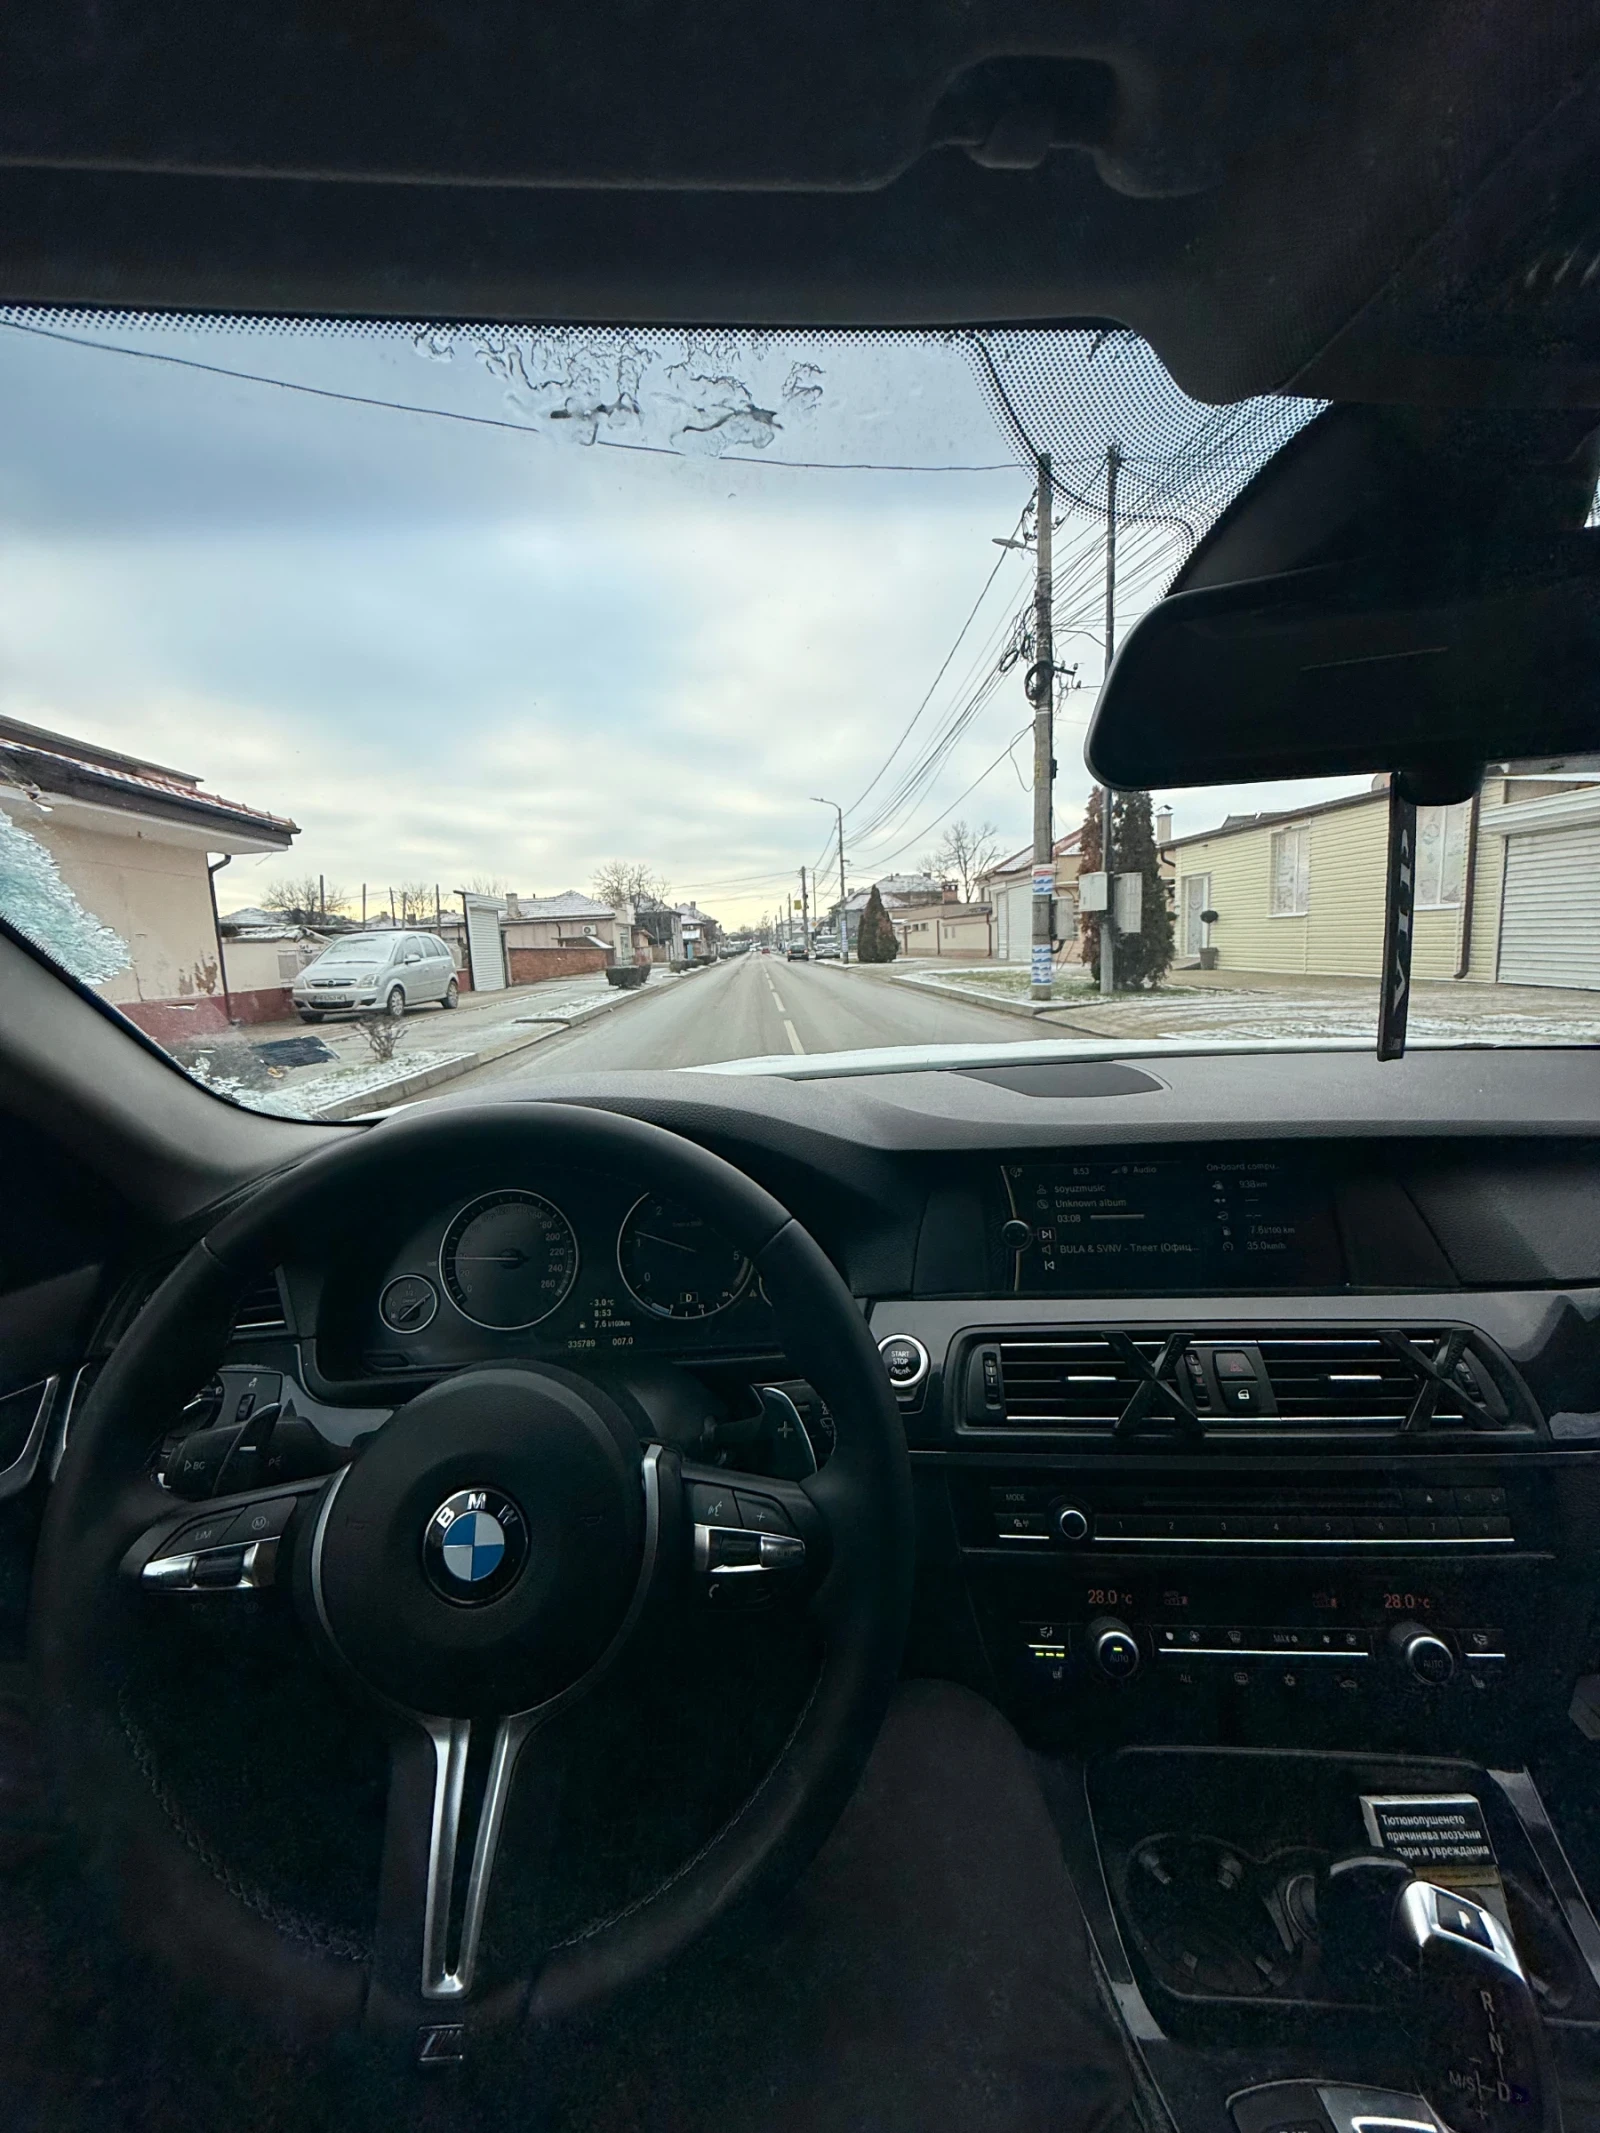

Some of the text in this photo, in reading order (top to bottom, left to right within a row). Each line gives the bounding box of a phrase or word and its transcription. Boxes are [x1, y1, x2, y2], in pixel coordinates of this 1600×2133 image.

[1132, 1165, 1157, 1174] Audio
[1206, 1163, 1245, 1171] On-board
[1054, 1183, 1106, 1194] soyuzmusic
[1055, 1198, 1127, 1208] Unknown album
[655, 1205, 663, 1216] 2
[1056, 1214, 1081, 1223] 03:08
[545, 1232, 561, 1241] 200
[549, 1247, 565, 1256] 220
[1059, 1245, 1086, 1254] BULA
[1087, 1244, 1094, 1253] &
[733, 1250, 740, 1261] 5
[460, 1269, 470, 1277] 20
[547, 1264, 563, 1272] 240
[643, 1271, 651, 1282] 0
[466, 1284, 473, 1293] 0
[540, 1280, 556, 1288] 260
[685, 1293, 692, 1303] D
[594, 1309, 612, 1318] 8:53
[594, 1319, 607, 1329] 7.6
[567, 1336, 634, 1348] 335789 007.0
[892, 1357, 909, 1365] STOP
[1005, 1493, 1026, 1501] MODE
[436, 1491, 519, 1527] BMW
[1118, 1520, 1123, 1529] 1
[1169, 1521, 1174, 1530] 2
[1221, 1521, 1227, 1531] 3
[1273, 1522, 1280, 1531] 4
[1325, 1522, 1331, 1531] 5
[1378, 1522, 1384, 1531] 6
[1431, 1522, 1436, 1531] 7
[1087, 1588, 1118, 1605] 28.0
[1383, 1592, 1415, 1609] 28.0
[1273, 1633, 1290, 1643] MAX
[1109, 1654, 1129, 1664] AUTO
[1423, 1659, 1444, 1669] AUTO
[1180, 1673, 1193, 1683] ALL
[1380, 1814, 1466, 1828] Тютюнопушенето
[1386, 1830, 1482, 1844] причинява мозъчни
[1421, 1847, 1430, 1856] и
[1428, 1845, 1490, 1860] увреждания
[1480, 1990, 1495, 2013] R
[1488, 2032, 1504, 2055] N
[1496, 2080, 1511, 2103] D
